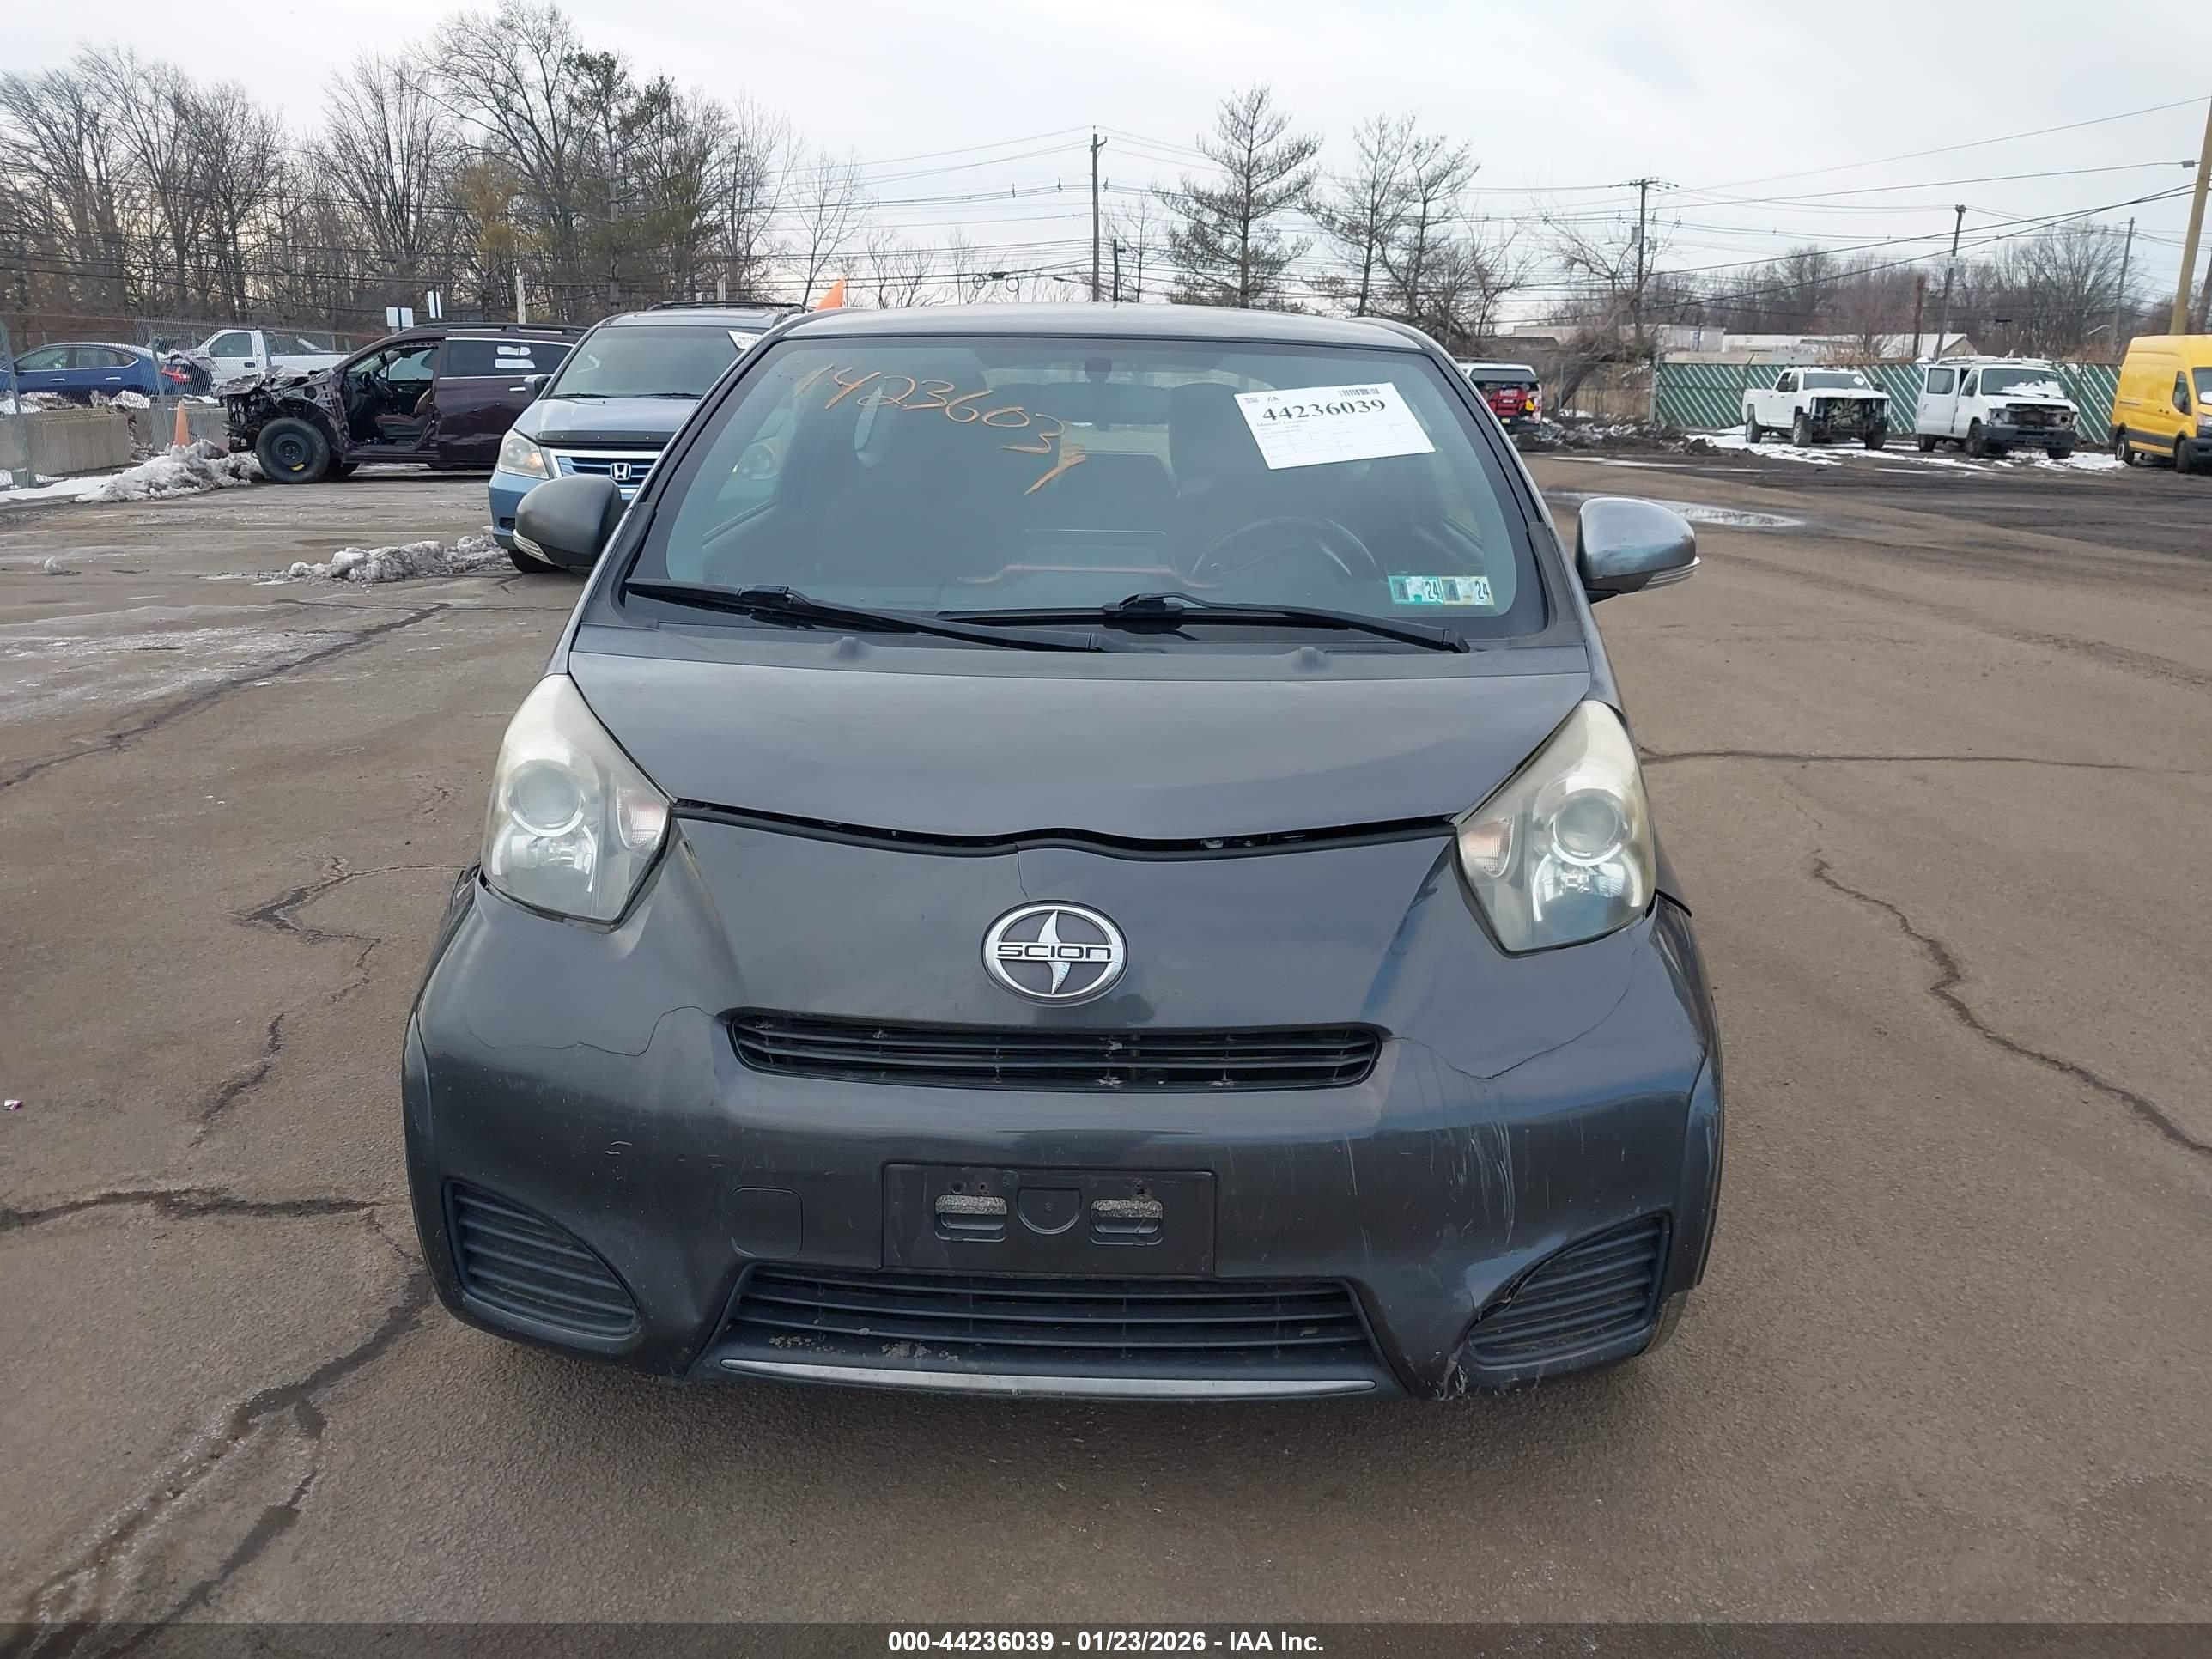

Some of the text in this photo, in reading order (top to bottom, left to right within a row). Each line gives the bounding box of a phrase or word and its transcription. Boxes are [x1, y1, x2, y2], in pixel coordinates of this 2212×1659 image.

[1262, 398, 1386, 420] 44236039
[793, 362, 1086, 496] 423603
[1425, 580, 1439, 599] 24
[1475, 580, 1490, 599] 24
[997, 945, 1112, 960] SCION
